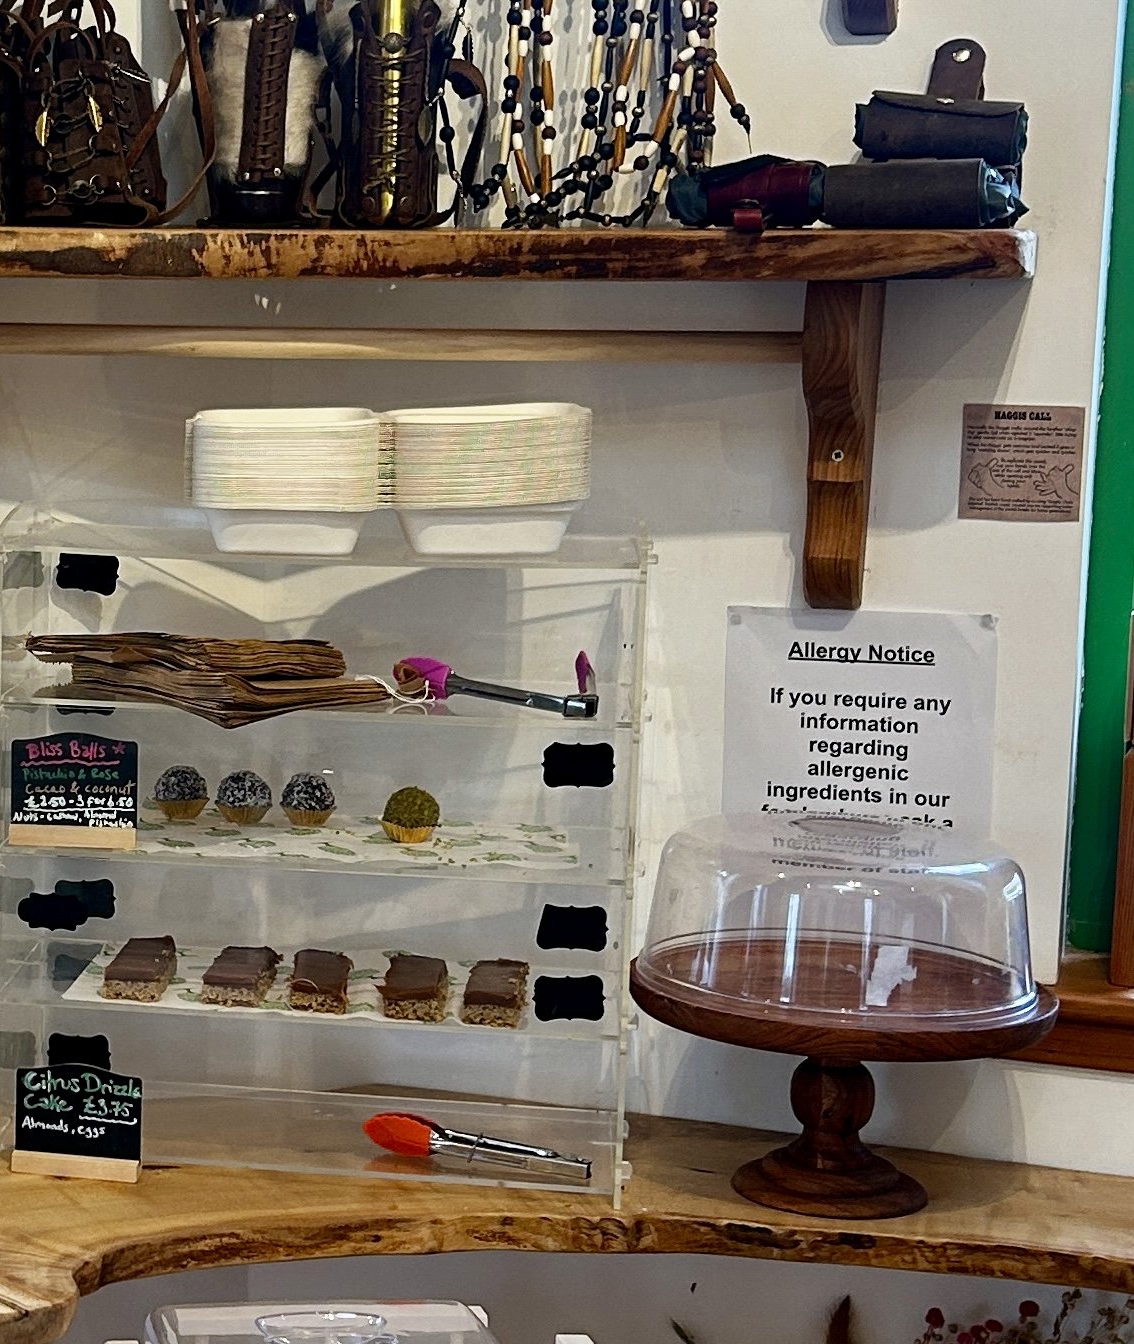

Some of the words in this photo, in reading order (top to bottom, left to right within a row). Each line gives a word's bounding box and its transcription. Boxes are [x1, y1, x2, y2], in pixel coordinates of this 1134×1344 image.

[994, 411, 1026, 420] HAGGIS
[1029, 412, 1052, 421] CALL
[788, 642, 861, 663] Allergy
[868, 644, 935, 663] Notice
[770, 688, 785, 704] If
[790, 692, 826, 708] you
[834, 692, 907, 712] require
[914, 696, 952, 716] any
[800, 713, 919, 734] information
[26, 740, 63, 760] Bliss
[69, 740, 106, 760] Balls
[809, 739, 908, 761] regarding
[77, 769, 86, 779] &
[808, 761, 908, 781] allergenic
[25, 783, 66, 794] Cacao
[70, 781, 80, 794] &
[766, 782, 882, 804] ingredients
[889, 788, 907, 804] in
[914, 792, 950, 808] our
[24, 796, 66, 808] £2.50
[76, 794, 84, 806] 3
[23, 1070, 80, 1093] Citrus
[81, 1072, 142, 1098] Drizzle
[24, 1094, 74, 1112] Cake
[83, 1096, 134, 1117] £3.75
